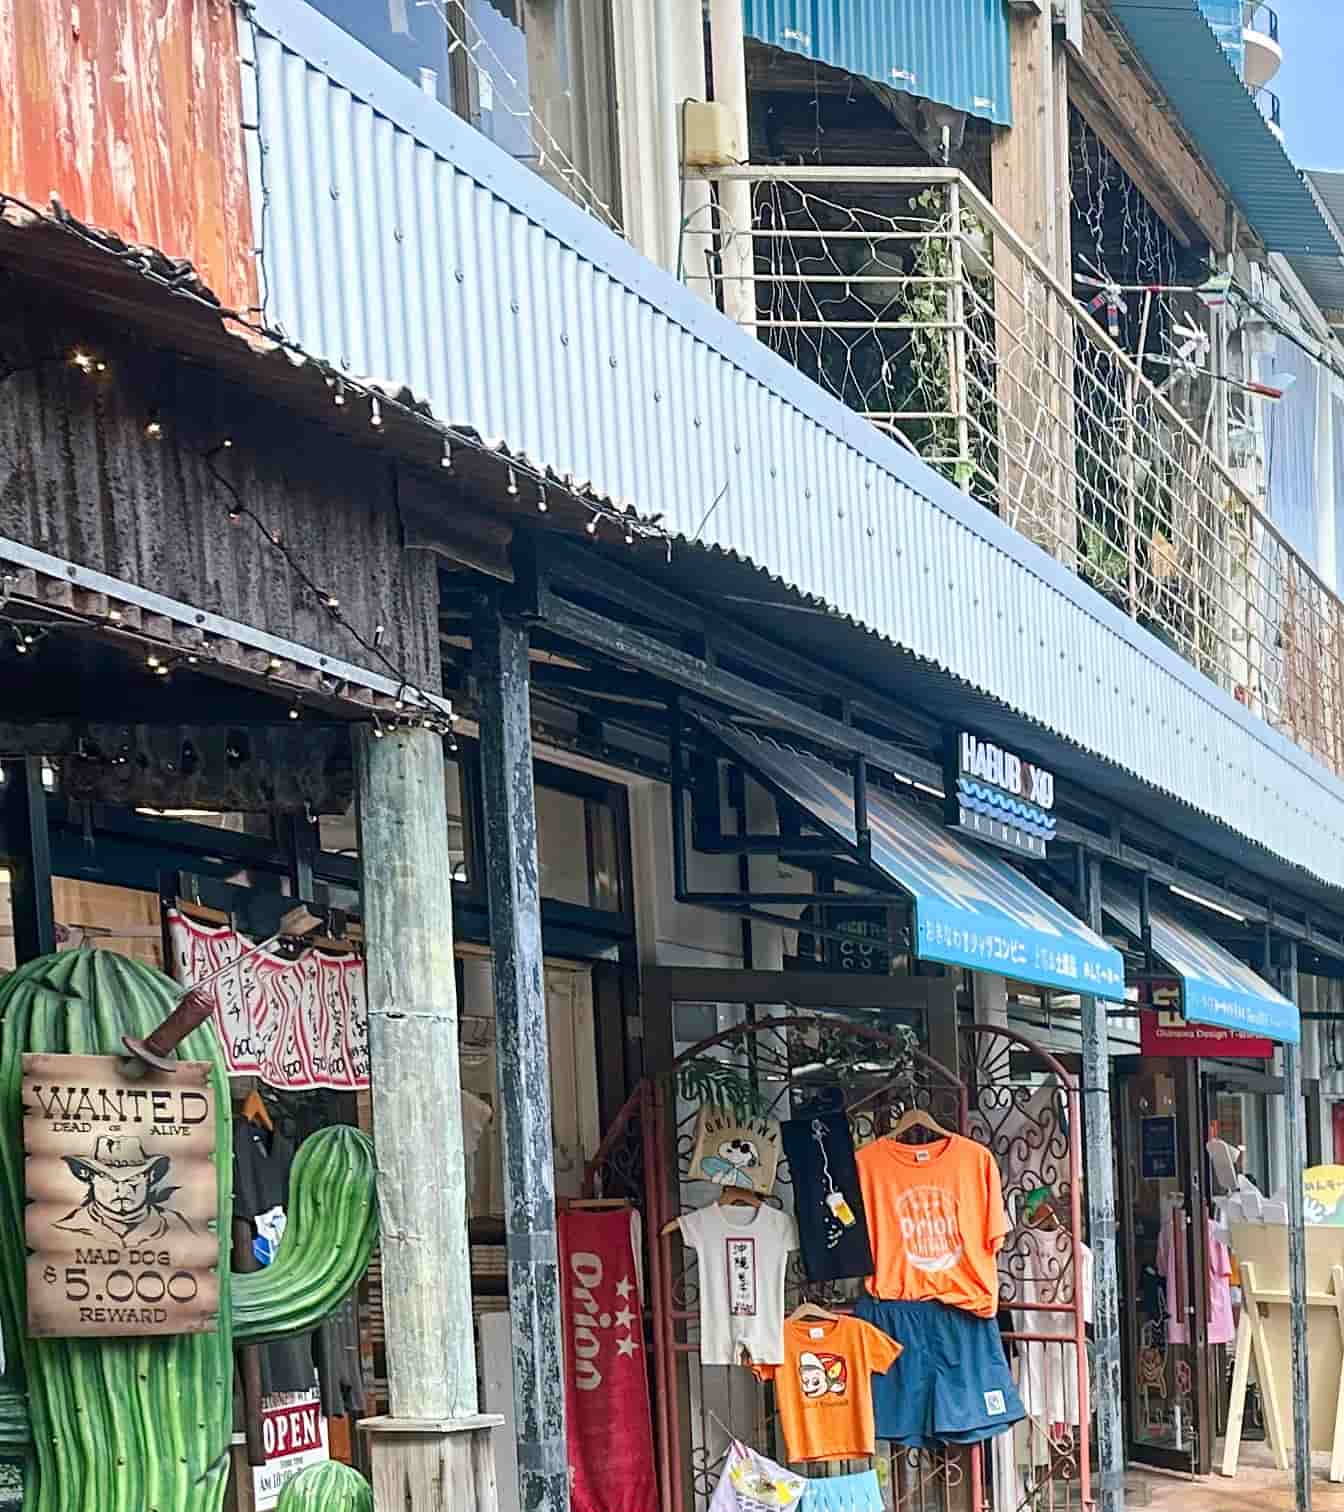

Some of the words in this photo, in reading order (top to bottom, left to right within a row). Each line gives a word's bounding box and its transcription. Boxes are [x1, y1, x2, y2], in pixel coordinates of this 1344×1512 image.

[32, 1086, 208, 1124] WANTED
[52, 1122, 92, 1133] DEAD
[150, 1124, 192, 1136] ALIVE
[75, 1249, 121, 1265] MAD
[129, 1250, 171, 1266] DOG
[79, 1307, 168, 1323] REWARD
[570, 1251, 613, 1391] Orion
[263, 1409, 316, 1454] OPEN
